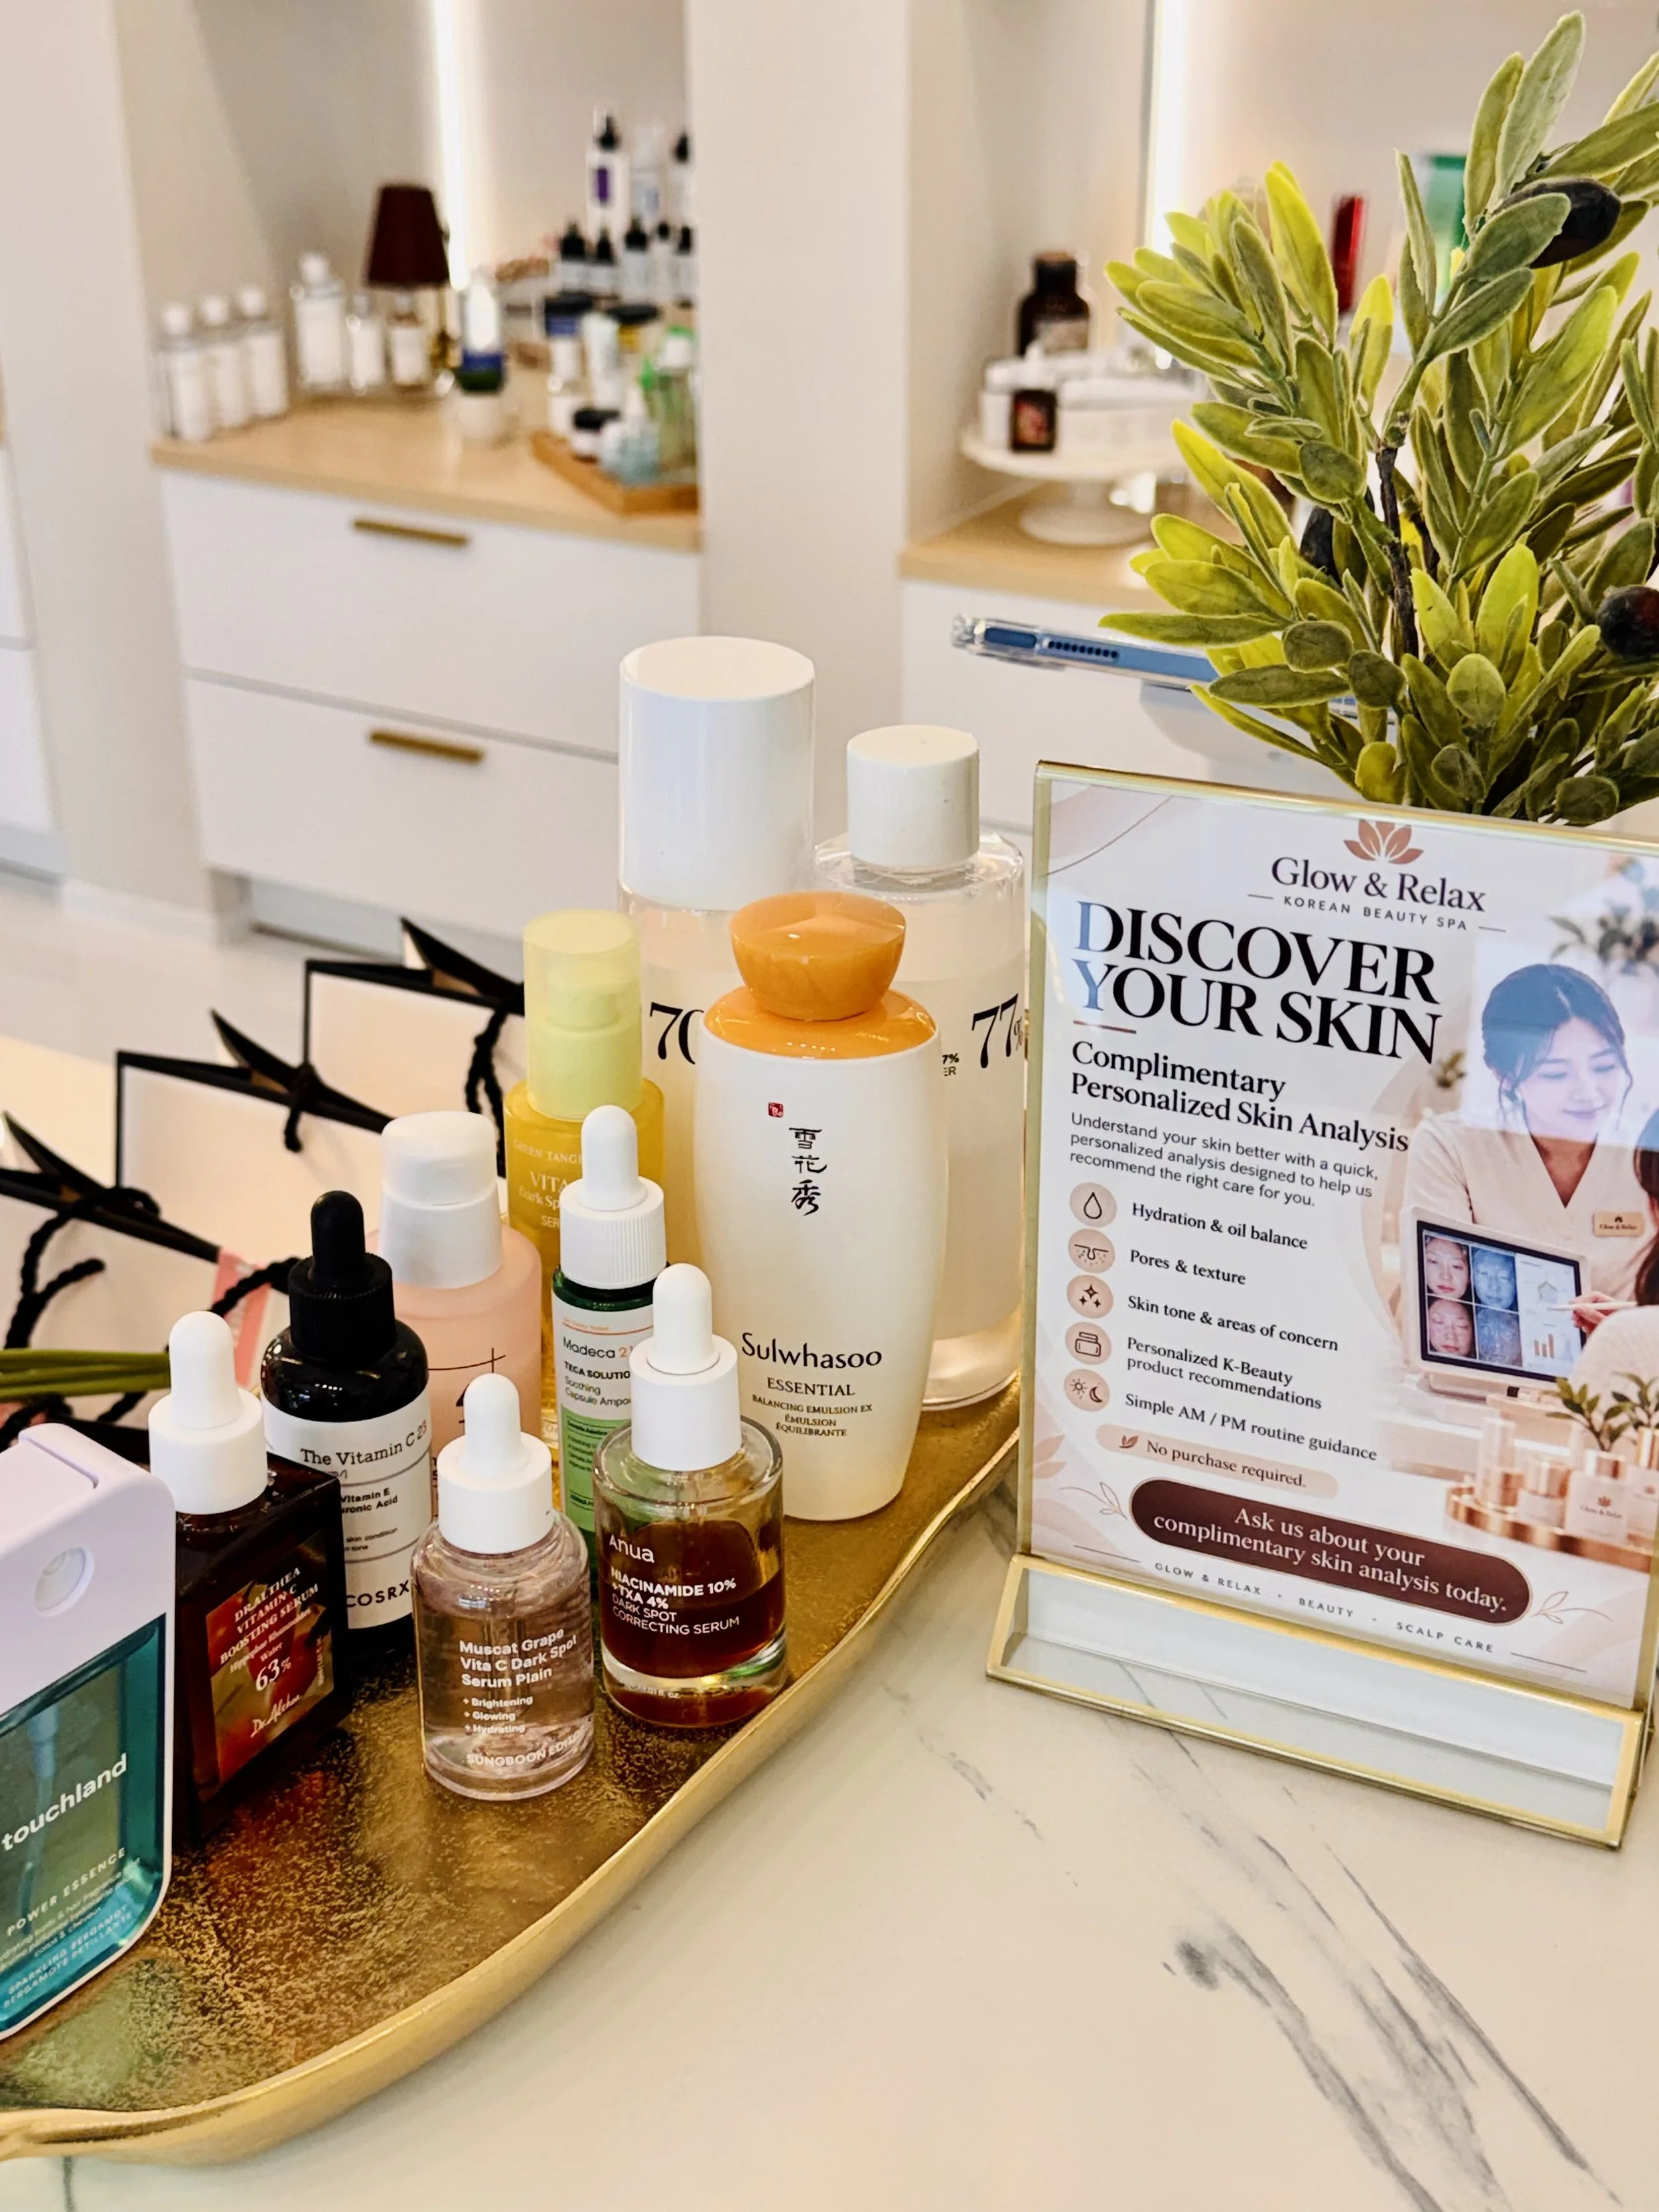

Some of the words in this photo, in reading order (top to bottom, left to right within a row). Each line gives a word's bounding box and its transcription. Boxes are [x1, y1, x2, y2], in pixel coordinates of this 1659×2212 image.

[1271, 856, 1357, 894] Glow
[1364, 874, 1388, 899] &
[1396, 872, 1487, 912] Relax
[1283, 895, 1351, 915] KOREAN
[1363, 907, 1429, 926] BEAUTY
[1437, 915, 1467, 931] SPA
[1074, 900, 1441, 1005] DISCOVER
[1073, 958, 1263, 1038] YOUR
[1276, 992, 1443, 1065] SKIN
[942, 1053, 960, 1065] 7%
[1072, 1040, 1287, 1102] Complimentary
[1071, 1072, 1231, 1121] Personalized
[1237, 1102, 1293, 1132] Skin
[1299, 1112, 1409, 1151] Analysis
[1071, 1112, 1158, 1140] Understand
[1162, 1130, 1197, 1147] your
[1202, 1136, 1232, 1153] skin
[1236, 1142, 1281, 1162] better
[1284, 1151, 1316, 1169] with
[1319, 1159, 1329, 1170] a
[1333, 1161, 1379, 1181] quick,
[788, 1127, 828, 1216] 雪花秀
[1070, 1133, 1164, 1160] personalized
[1167, 1147, 1226, 1171] analysis
[1229, 1161, 1296, 1184] designed
[1300, 1173, 1315, 1187] to
[1319, 1175, 1351, 1197] help
[1355, 1185, 1372, 1198] us
[1070, 1151, 1156, 1177] recommend
[1159, 1166, 1183, 1183] the
[1186, 1172, 1220, 1191] right
[1222, 1181, 1255, 1195] care
[1259, 1185, 1281, 1199] for
[1284, 1192, 1316, 1210] you.
[545, 1195, 560, 1211] Sp
[1131, 1203, 1206, 1230] Hydration
[1210, 1219, 1224, 1233] &
[1227, 1222, 1246, 1238] oil
[1250, 1225, 1308, 1250] balance
[1130, 1249, 1171, 1270] Pores
[1175, 1260, 1189, 1273] &
[1192, 1262, 1247, 1285] texture
[1127, 1295, 1159, 1316] Skin
[1163, 1304, 1196, 1323] tone
[1199, 1311, 1214, 1325] &
[1217, 1316, 1256, 1334] areas
[1260, 1322, 1277, 1338] of
[1279, 1328, 1339, 1352] concern
[563, 1336, 616, 1359] Madeca
[741, 1331, 883, 1369] Sulwhasoo
[1127, 1337, 1219, 1369] Personalized
[1222, 1357, 1293, 1386] K-Beauty
[564, 1360, 585, 1377] TECA
[587, 1370, 631, 1380] SOLUTIO
[564, 1375, 601, 1396] Soothing
[766, 1377, 856, 1396] ESSENTIAL
[1126, 1357, 1185, 1380] product
[1188, 1369, 1323, 1410] recommendations
[565, 1386, 598, 1405] Capsule
[752, 1394, 804, 1413] BALANCING
[806, 1404, 858, 1415] EMULSION
[861, 1403, 873, 1413] EX
[784, 1414, 837, 1427] ÉMULSION
[1125, 1392, 1175, 1418] Simple
[1178, 1404, 1206, 1423] AM
[1209, 1412, 1218, 1427] /
[1221, 1414, 1246, 1433] PM
[1250, 1421, 1305, 1445] routine
[1308, 1434, 1378, 1462] guidance
[301, 1447, 332, 1465] The
[335, 1442, 403, 1465] Vitamin
[405, 1432, 415, 1447] C
[417, 1419, 427, 1440] 23
[1146, 1439, 1169, 1456] No
[1171, 1445, 1238, 1475] purchase
[1241, 1463, 1307, 1489] required.
[340, 1491, 381, 1503] Vitamin
[383, 1487, 390, 1497] E
[376, 1495, 398, 1510] Acid
[609, 1534, 655, 1564] Anua
[1234, 1507, 1276, 1534] Ask
[1279, 1521, 1305, 1539] us
[1308, 1526, 1370, 1556] about
[1375, 1542, 1425, 1572] your
[1153, 1512, 1307, 1568] complimentary
[1310, 1546, 1354, 1576] skin
[1358, 1558, 1441, 1600] analysis
[1445, 1582, 1508, 1613] today.
[346, 1579, 410, 1608] COSRX
[610, 1566, 705, 1597] NIACINAMIDE
[707, 1577, 737, 1595] 10%
[611, 1582, 644, 1605] +TXA
[646, 1595, 669, 1610] 4%
[220, 1613, 279, 1665] BOOSTING
[279, 1582, 319, 1618] SERUM
[236, 1591, 288, 1634] VITAMIN
[289, 1584, 298, 1595] C
[612, 1593, 640, 1615] DARK
[642, 1607, 678, 1622] SPOT
[612, 1606, 691, 1635] CORRECTING
[693, 1615, 740, 1635] SERUM
[1155, 1561, 1194, 1580] GLOW
[1201, 1573, 1211, 1583] &
[1217, 1576, 1263, 1596] RELAX
[1298, 1597, 1355, 1619] BEAUTY
[1396, 1621, 1445, 1641] SCALP
[1453, 1635, 1494, 1654] CARE
[459, 1639, 518, 1656] Muscat
[521, 1628, 564, 1652] Grape
[460, 1657, 492, 1672] Vita
[494, 1659, 508, 1672] C
[511, 1651, 547, 1670] Dark
[549, 1634, 577, 1659] Spot
[461, 1673, 512, 1688] Serum
[515, 1666, 553, 1686] Plain
[470, 1696, 534, 1710] Brightening
[472, 1710, 516, 1722] Glowing
[472, 1723, 526, 1735] Hydrating
[466, 1749, 547, 1767] SUNGBOON
[1, 1752, 127, 1852] touchland
[7, 1895, 58, 1937] POWER
[63, 1847, 125, 1897] ESSENCE
